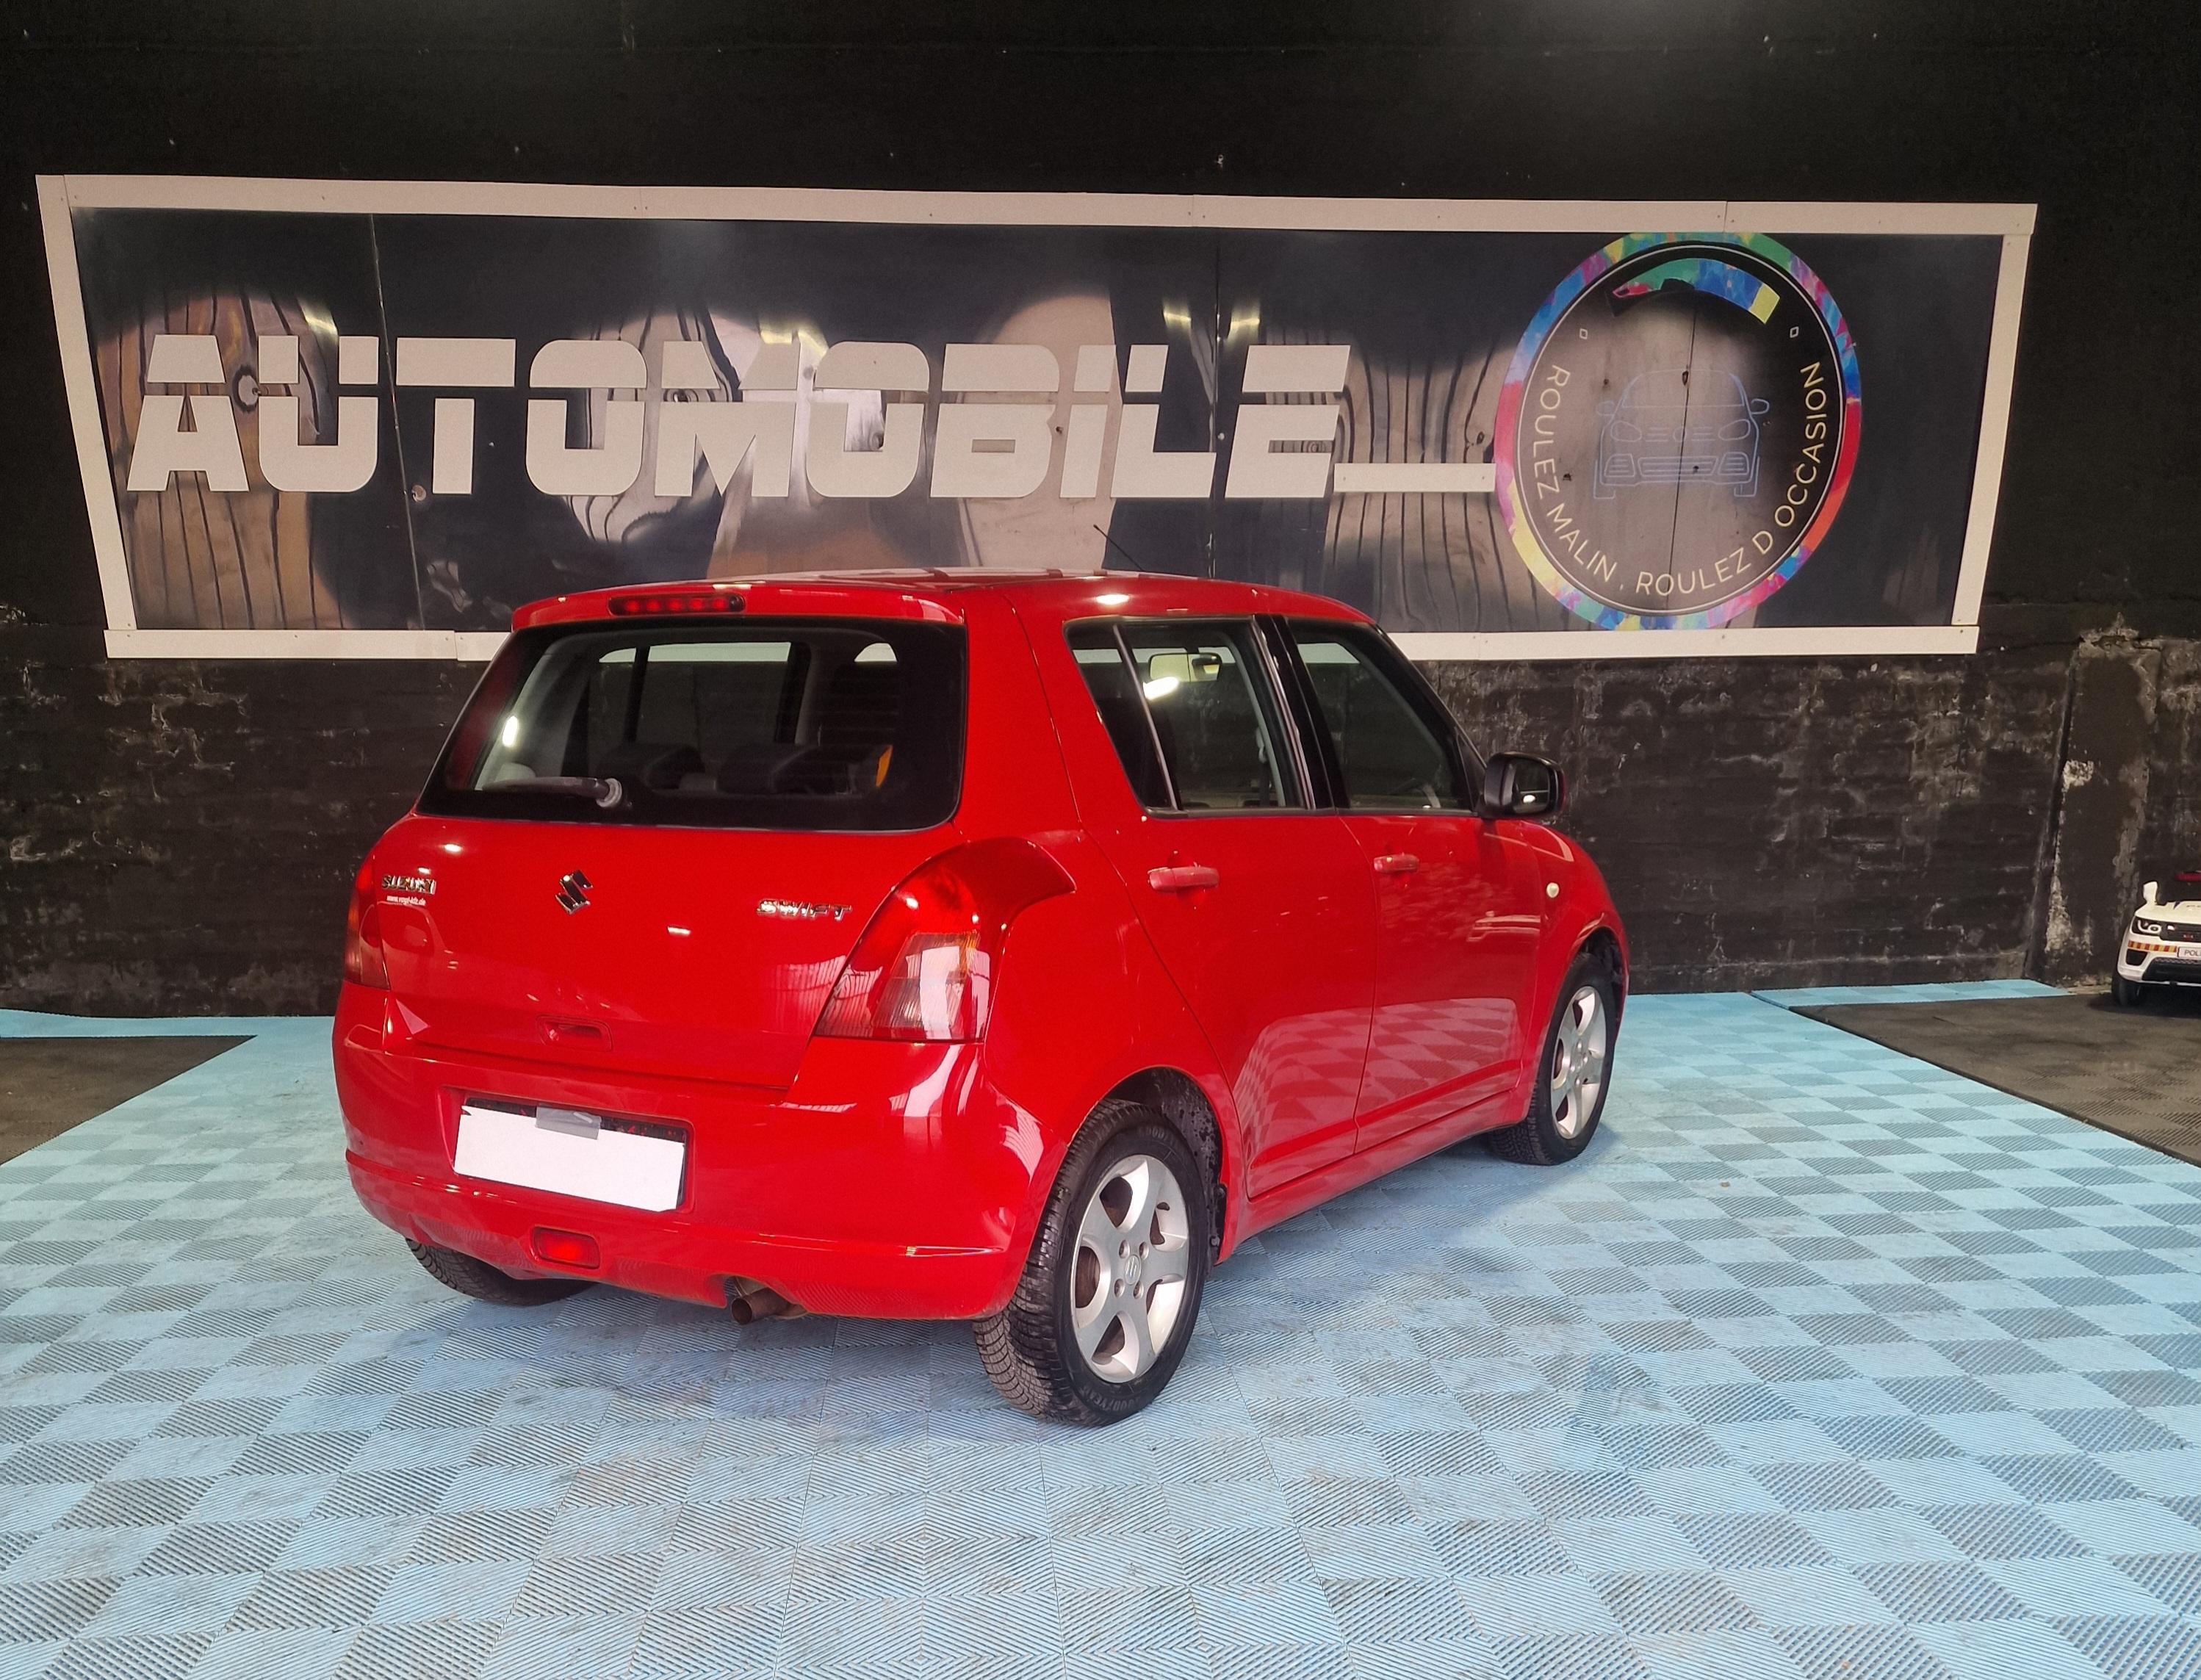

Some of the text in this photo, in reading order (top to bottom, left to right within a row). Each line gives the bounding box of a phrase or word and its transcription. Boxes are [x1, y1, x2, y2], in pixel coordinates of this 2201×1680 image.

[127, 334, 1350, 498] AUTOMOBILE
[1532, 364, 1571, 500] ROULEZ
[1635, 547, 1751, 596] ROULEZ
[1751, 530, 1773, 555] D
[1774, 361, 1827, 527] OCCASION
[757, 898, 852, 920] SWIFT
